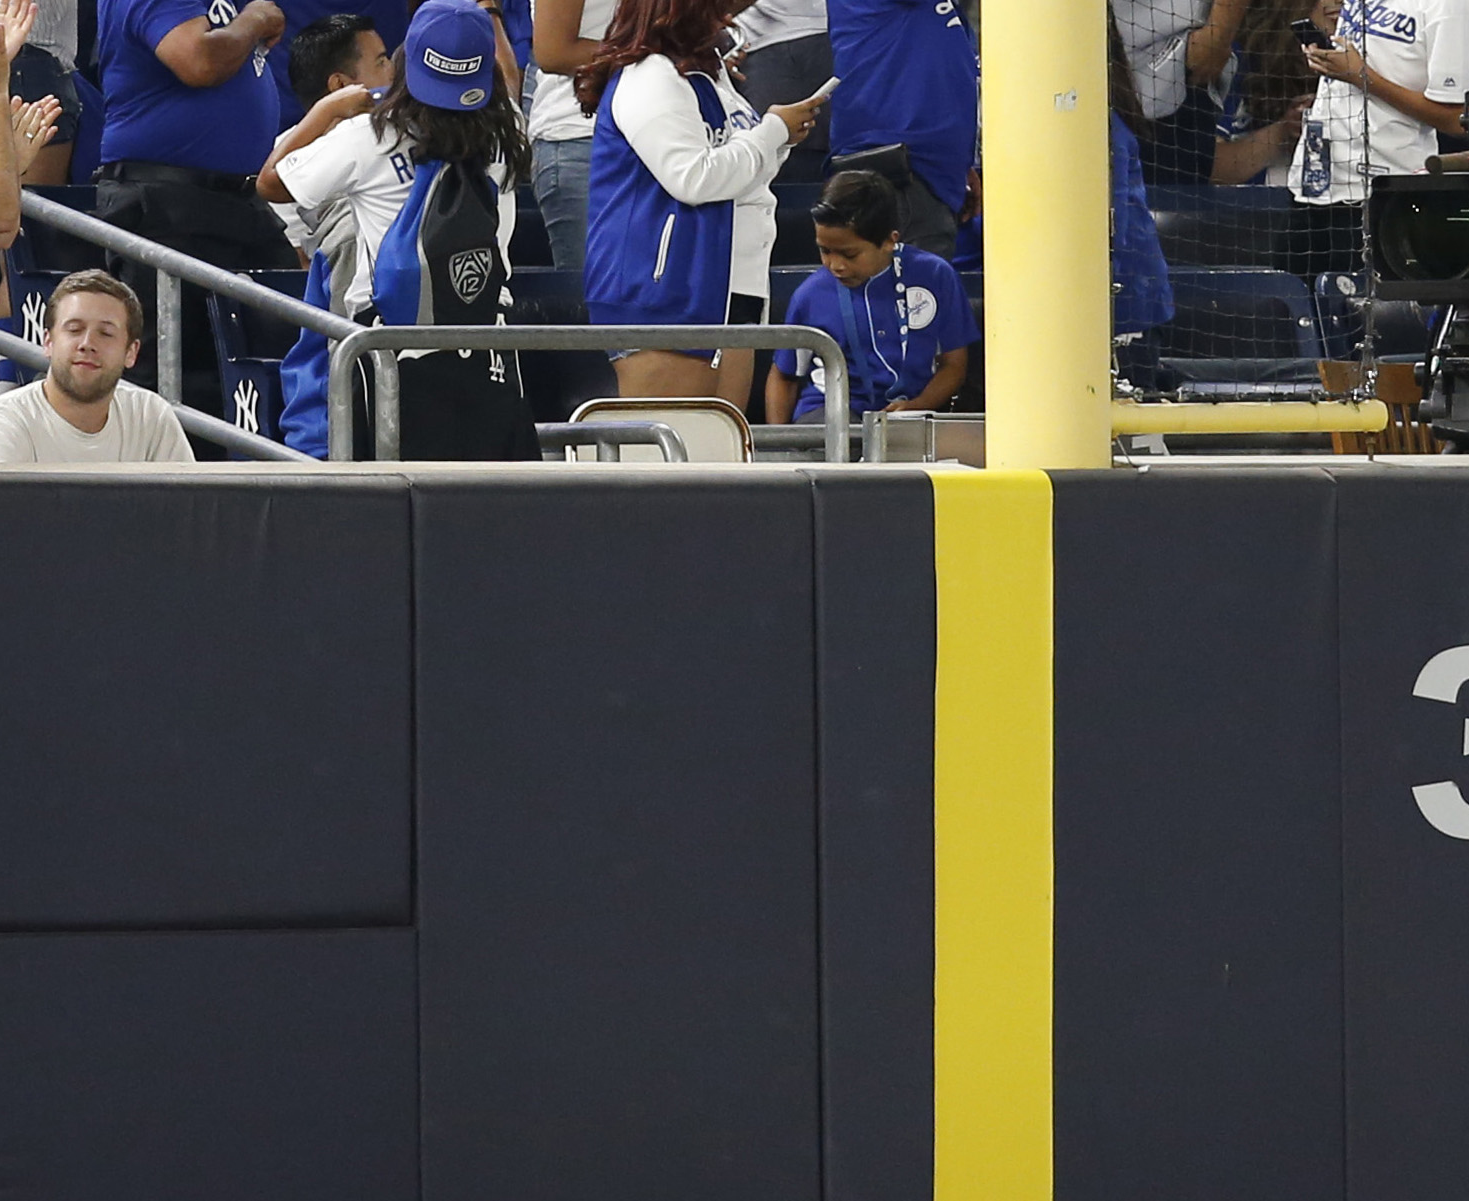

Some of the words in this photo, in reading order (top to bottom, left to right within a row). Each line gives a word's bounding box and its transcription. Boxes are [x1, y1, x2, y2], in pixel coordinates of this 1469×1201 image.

[462, 277, 479, 294] 12
[21, 291, 47, 346] NY
[233, 379, 259, 434] NY
